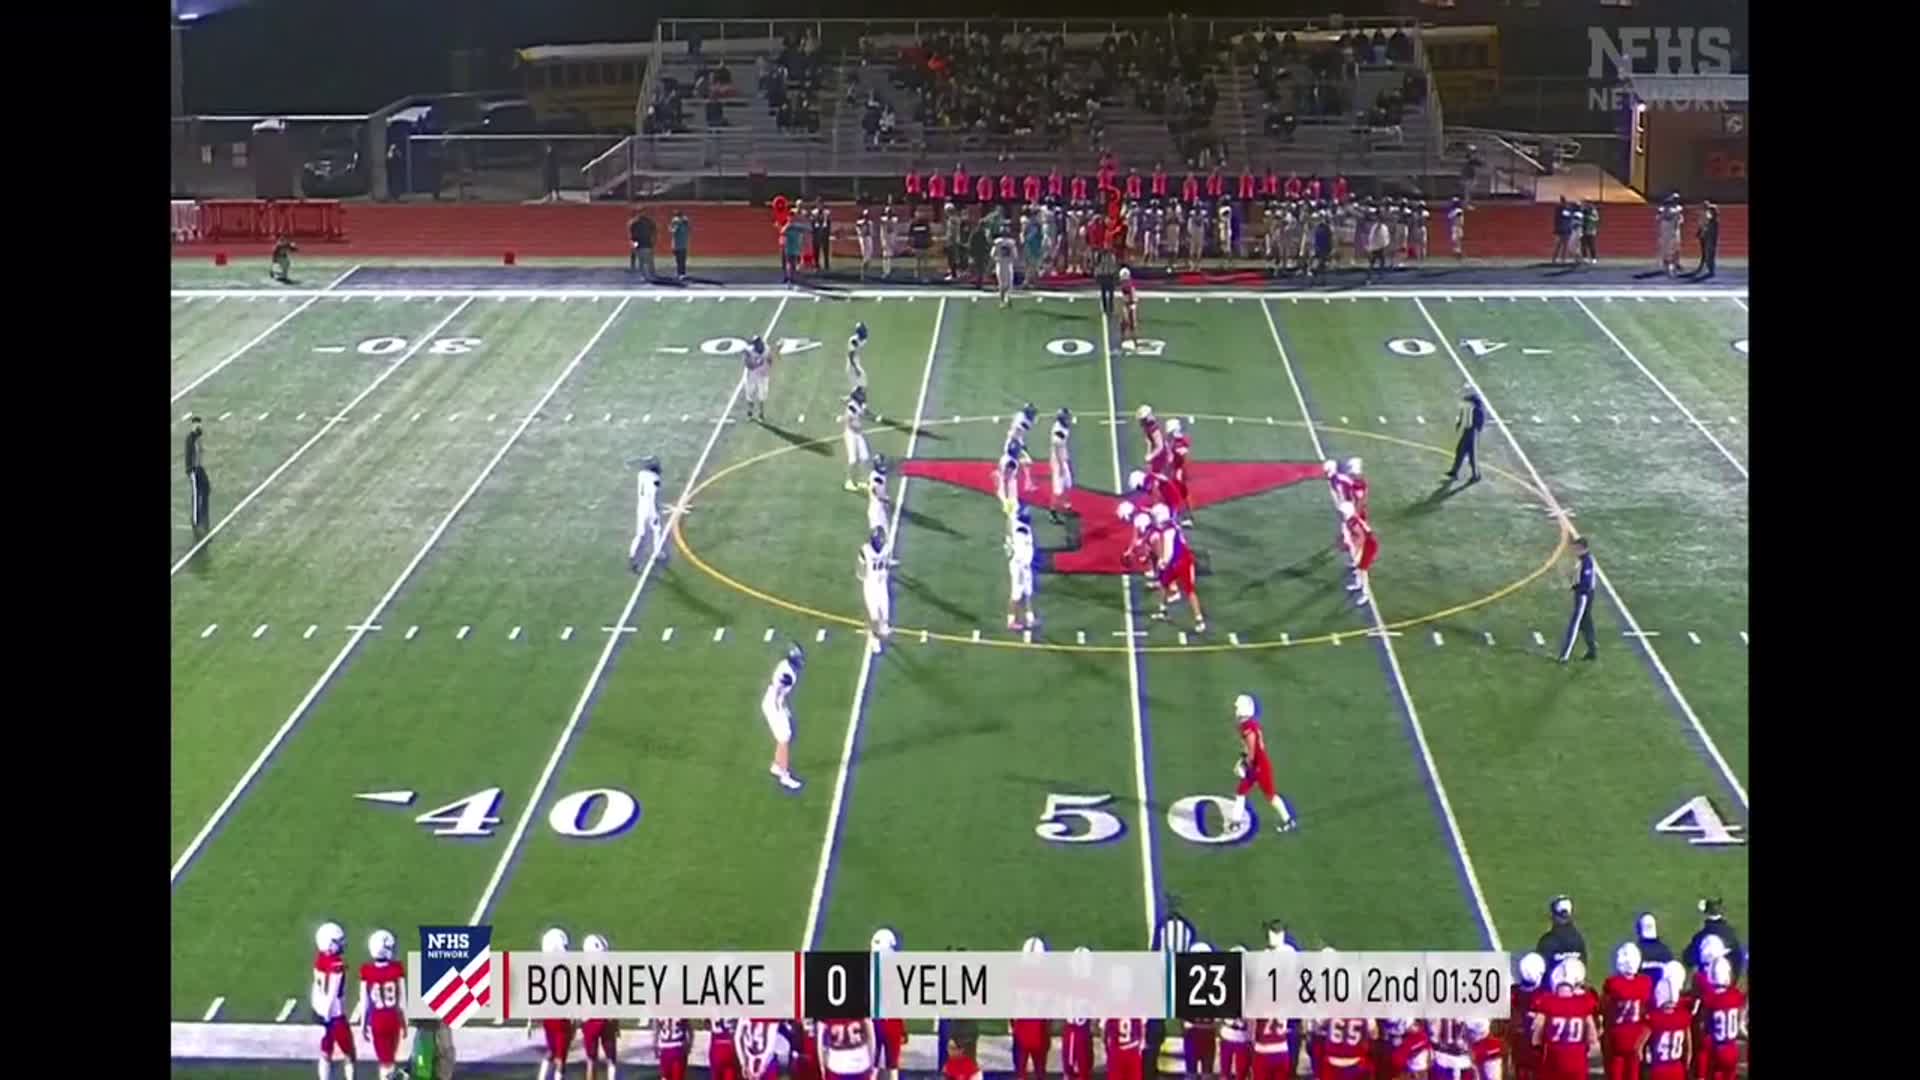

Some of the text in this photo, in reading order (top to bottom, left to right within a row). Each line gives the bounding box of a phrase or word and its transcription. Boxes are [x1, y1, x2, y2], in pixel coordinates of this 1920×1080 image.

[1330, 1018, 1364, 1046] 65
[1551, 1017, 1584, 1043] 70
[1714, 1008, 1739, 1042] 30
